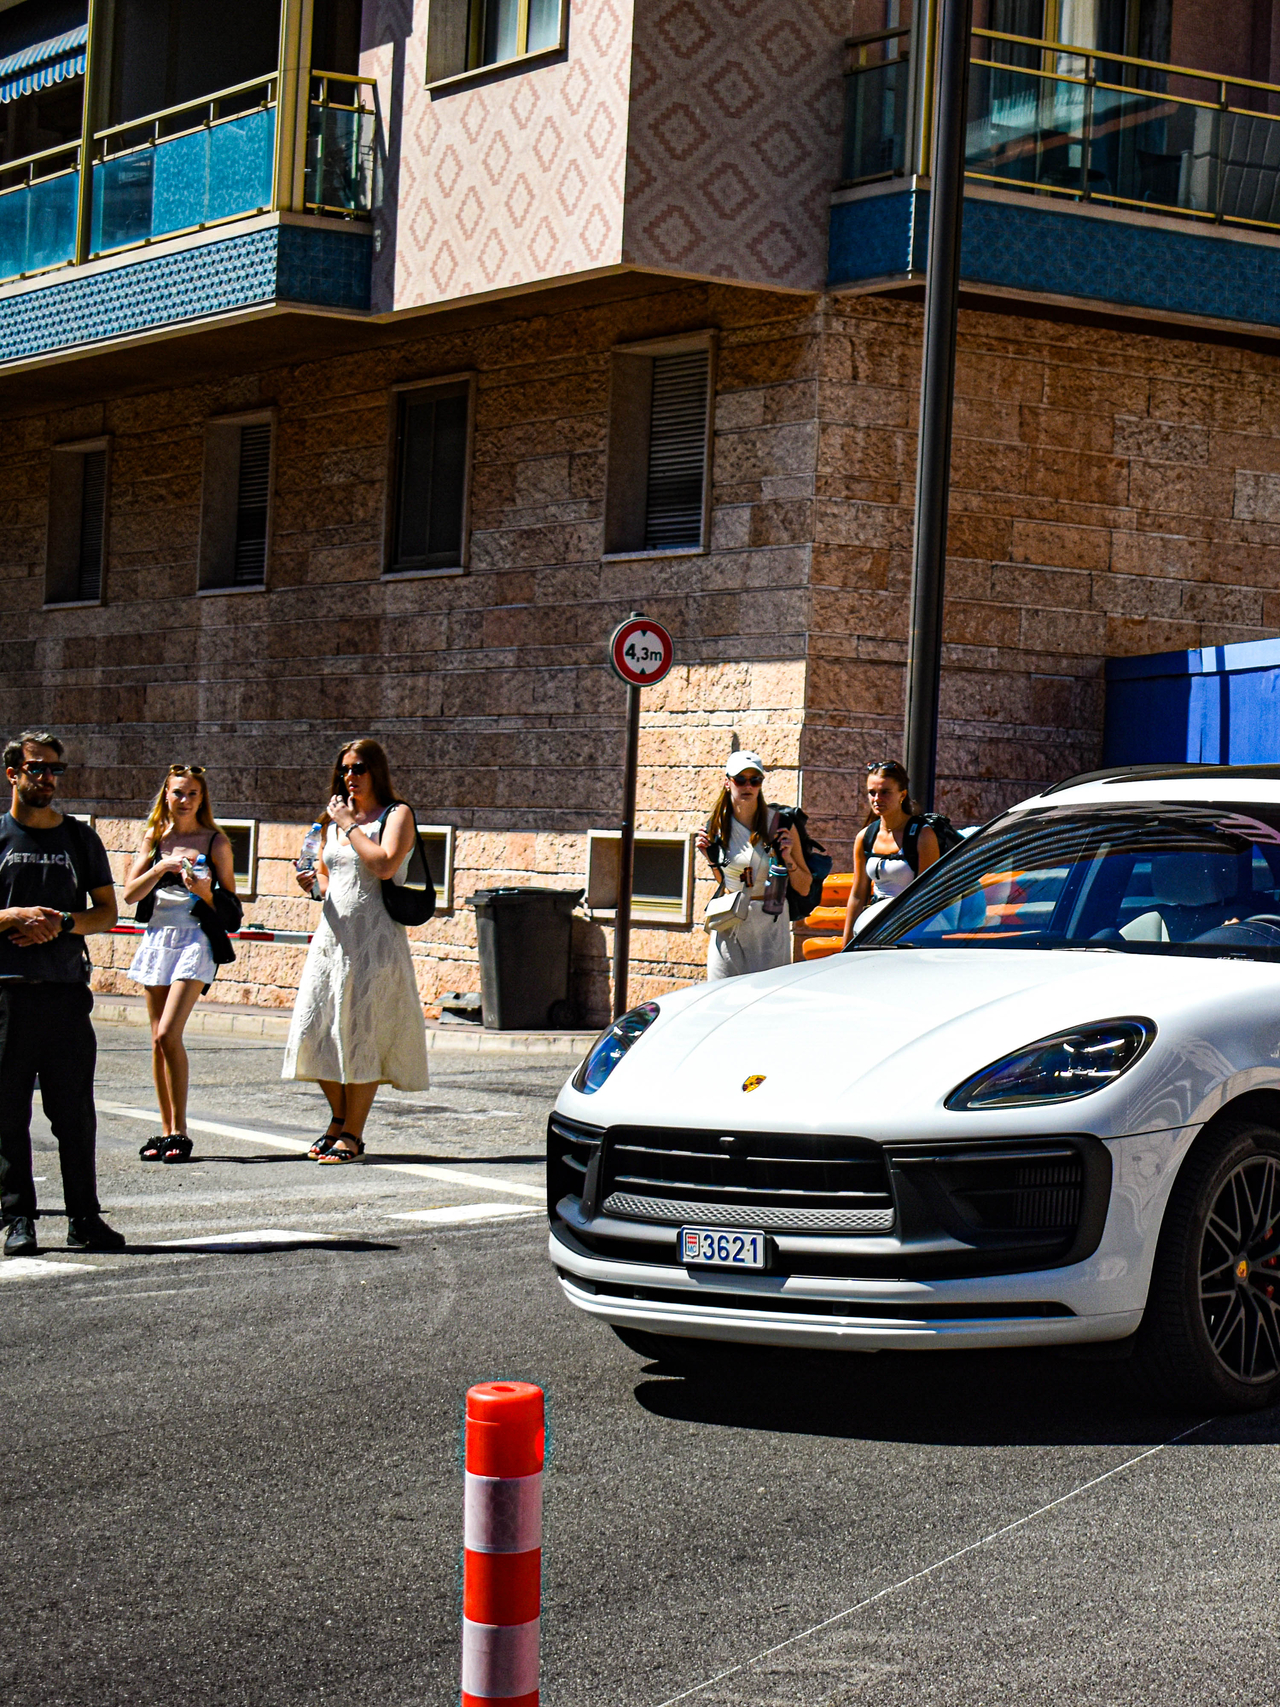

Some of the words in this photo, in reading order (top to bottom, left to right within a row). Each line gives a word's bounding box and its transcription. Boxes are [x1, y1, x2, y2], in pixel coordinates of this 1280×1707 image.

[624, 643, 662, 662] 4,3m
[0, 848, 75, 876] METALLICA
[703, 1233, 758, 1264] 3621
